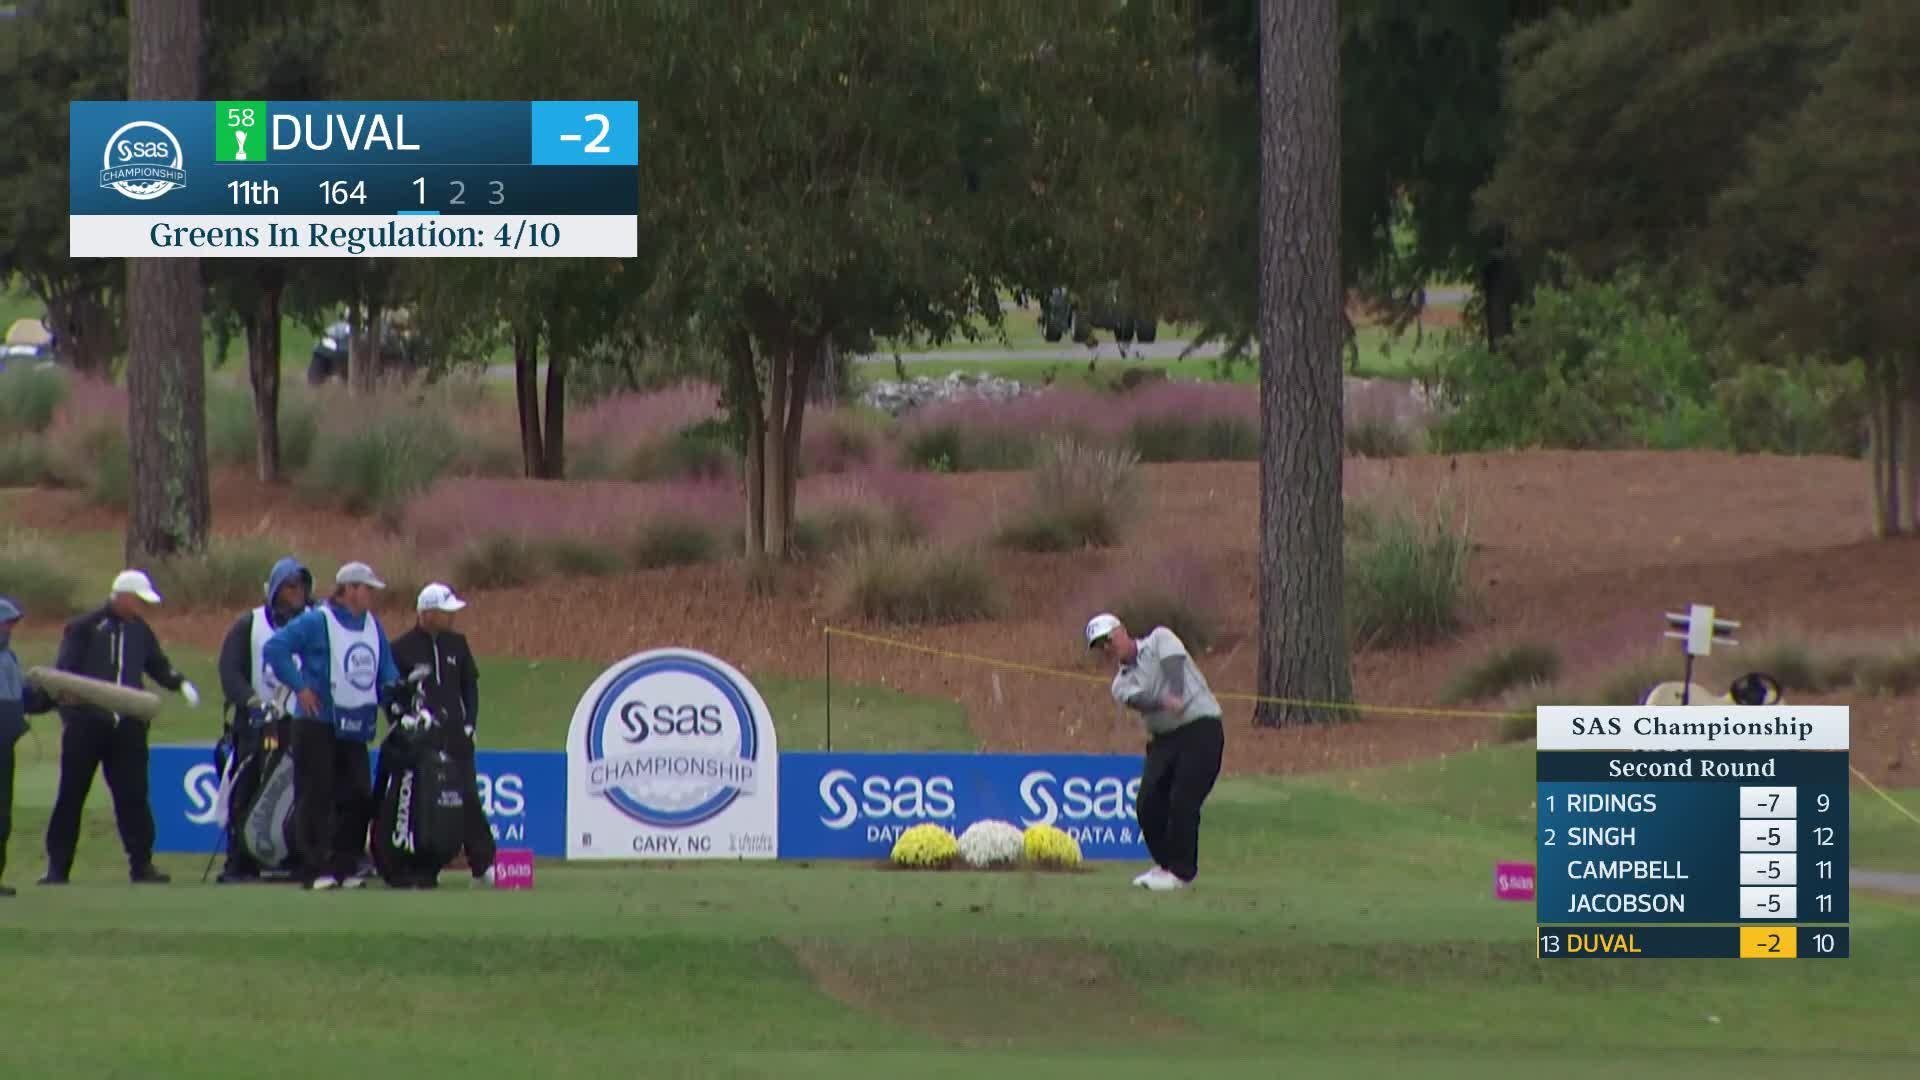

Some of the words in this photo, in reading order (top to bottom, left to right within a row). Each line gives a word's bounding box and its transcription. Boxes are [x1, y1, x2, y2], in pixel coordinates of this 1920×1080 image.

[591, 755, 753, 785] CHAMPIONSHIP
[867, 825, 904, 843] DAT
[632, 835, 682, 854] CARY,
[687, 835, 711, 852] NC
